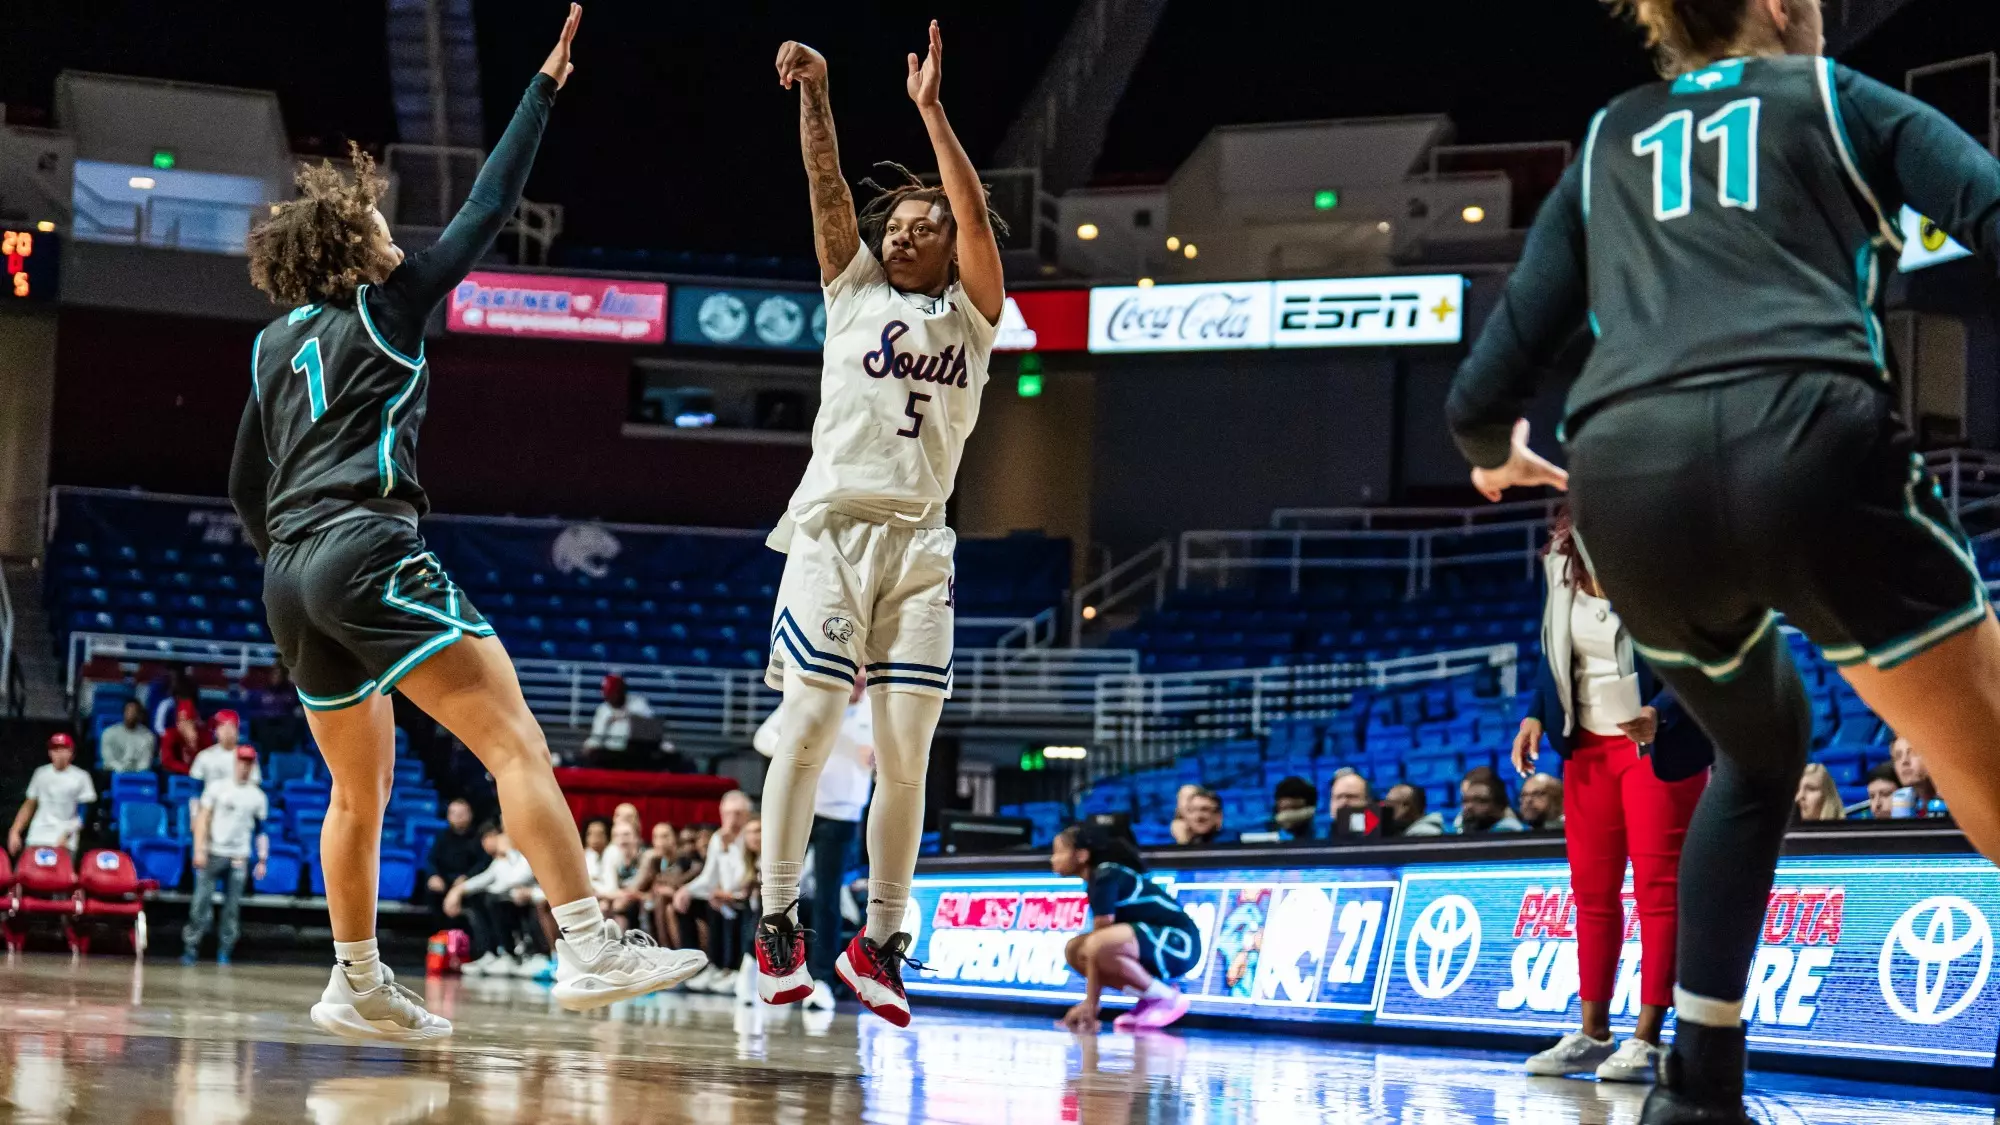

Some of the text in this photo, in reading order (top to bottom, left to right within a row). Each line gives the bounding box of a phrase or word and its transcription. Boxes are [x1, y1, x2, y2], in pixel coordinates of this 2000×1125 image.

[1632, 97, 1761, 222] 11
[291, 336, 328, 423] 1
[863, 320, 967, 389] South
[896, 391, 933, 439] 5
[1328, 900, 1383, 984] 27
